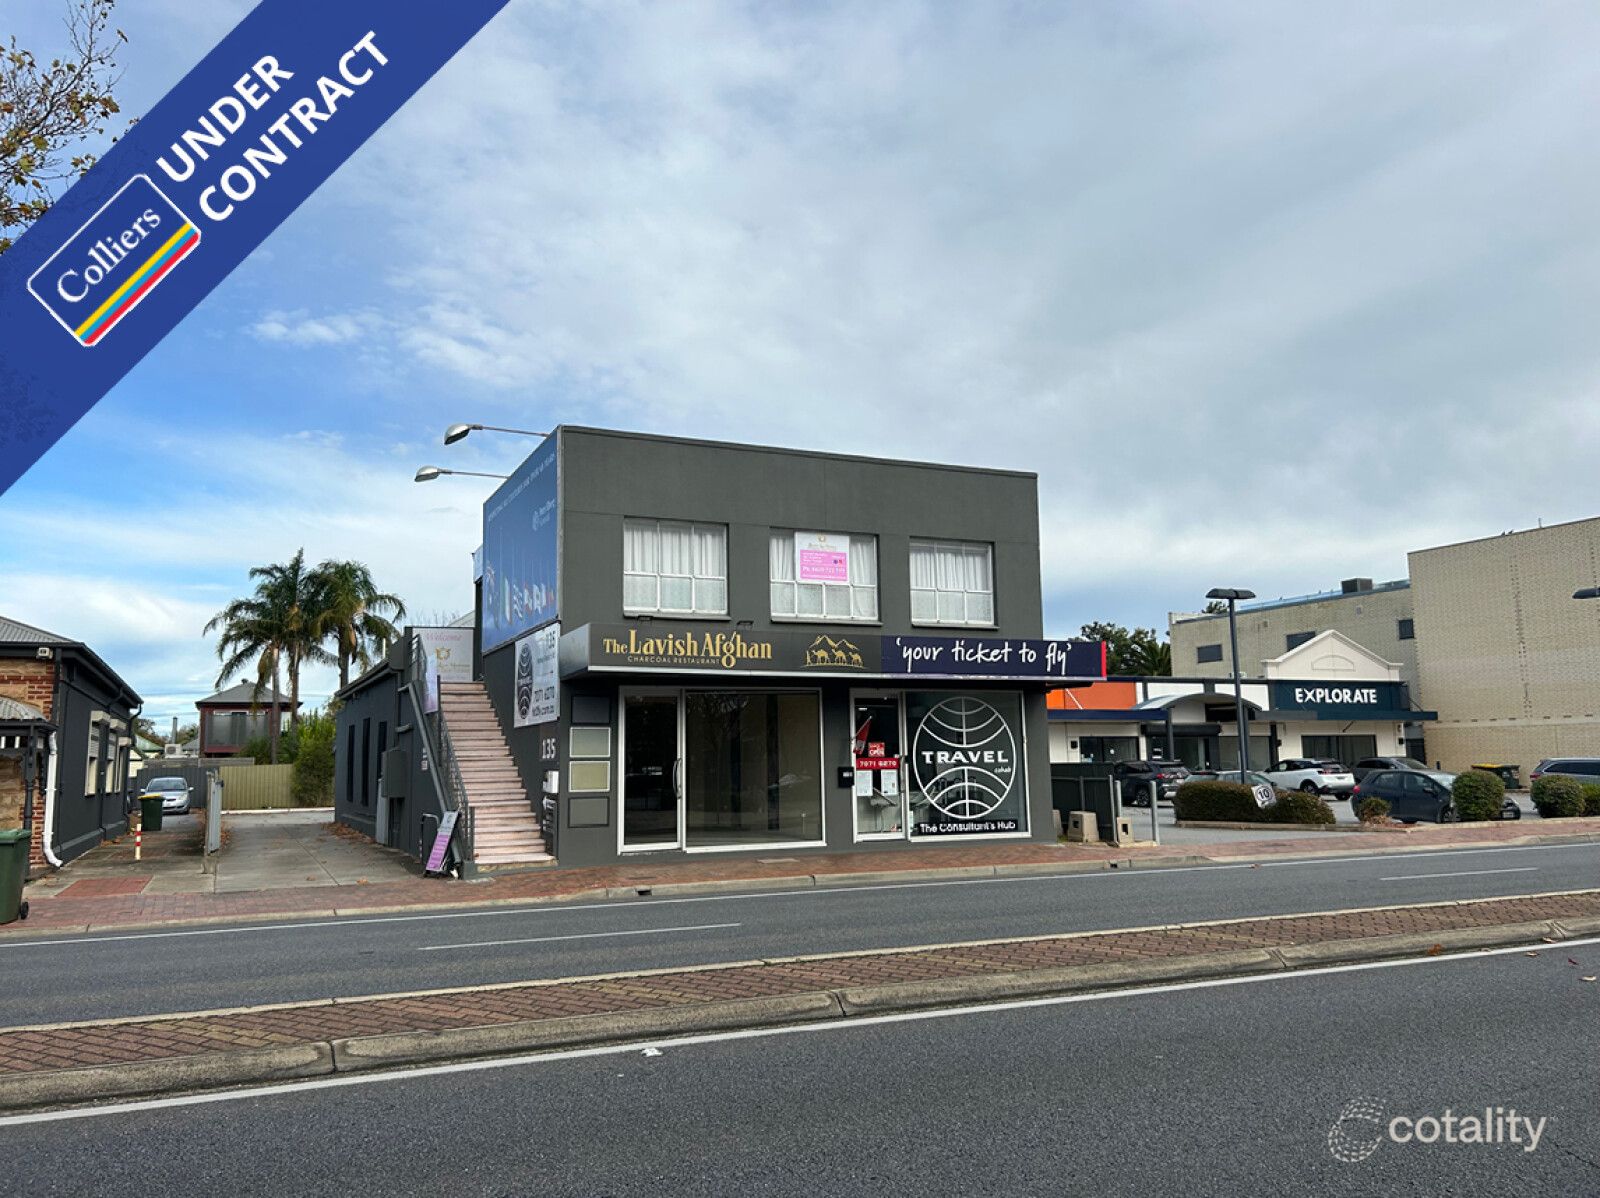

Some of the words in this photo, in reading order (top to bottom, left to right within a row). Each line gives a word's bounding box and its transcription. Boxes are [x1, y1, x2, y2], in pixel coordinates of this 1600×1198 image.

[602, 637, 628, 655] The
[628, 629, 699, 657] Lavish
[701, 630, 773, 669] Afghan
[951, 640, 1013, 664] ticket
[1018, 646, 1037, 663] to
[627, 655, 672, 664] CHARCOAL
[673, 656, 720, 666] RESTAURANT
[1295, 687, 1378, 704] EXPLORATE
[541, 738, 556, 760] 135
[921, 750, 1009, 764] TRAVEL
[1258, 788, 1270, 799] 10
[920, 823, 938, 833] The
[997, 820, 1016, 830] Hub
